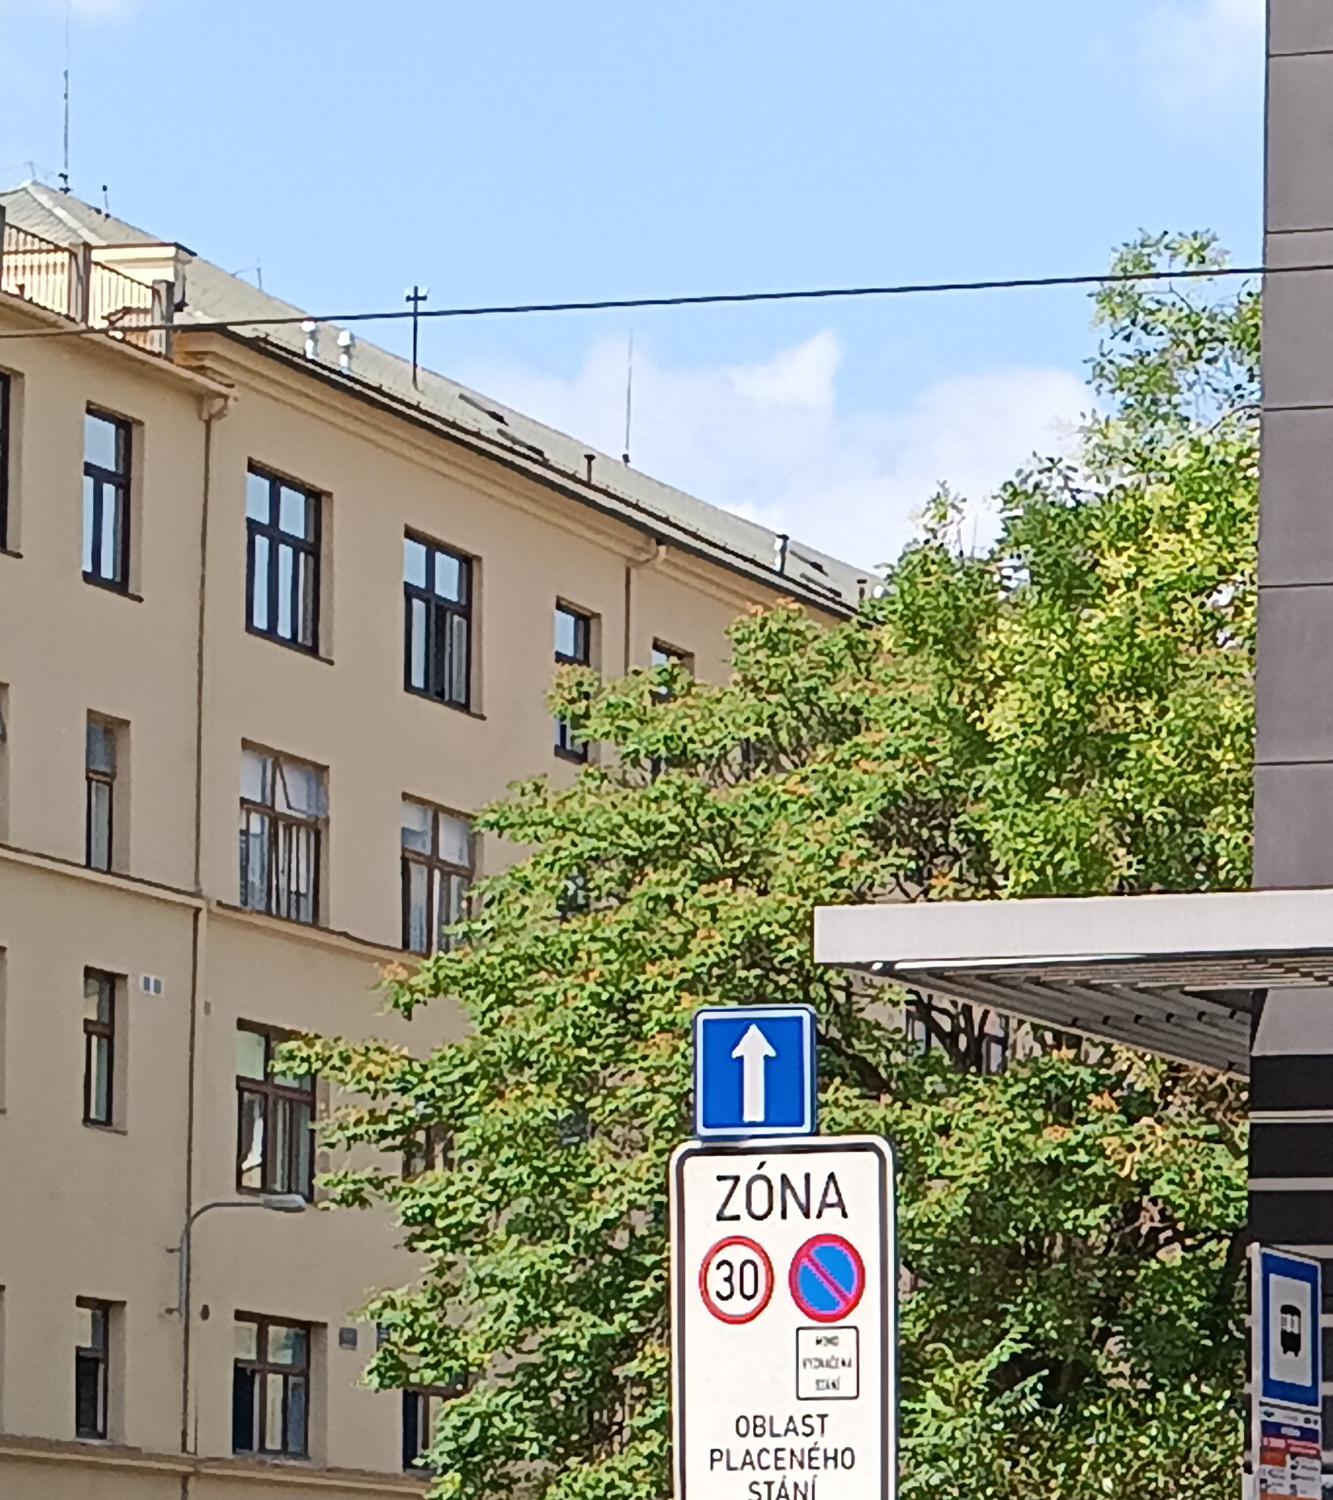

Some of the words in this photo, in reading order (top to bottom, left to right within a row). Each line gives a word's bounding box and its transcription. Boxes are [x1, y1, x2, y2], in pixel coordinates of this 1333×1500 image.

[716, 1161, 848, 1221] ZÓNA
[716, 1259, 758, 1301] 30
[735, 1413, 829, 1438] OBLAST
[709, 1441, 855, 1471] PLACENÉHO
